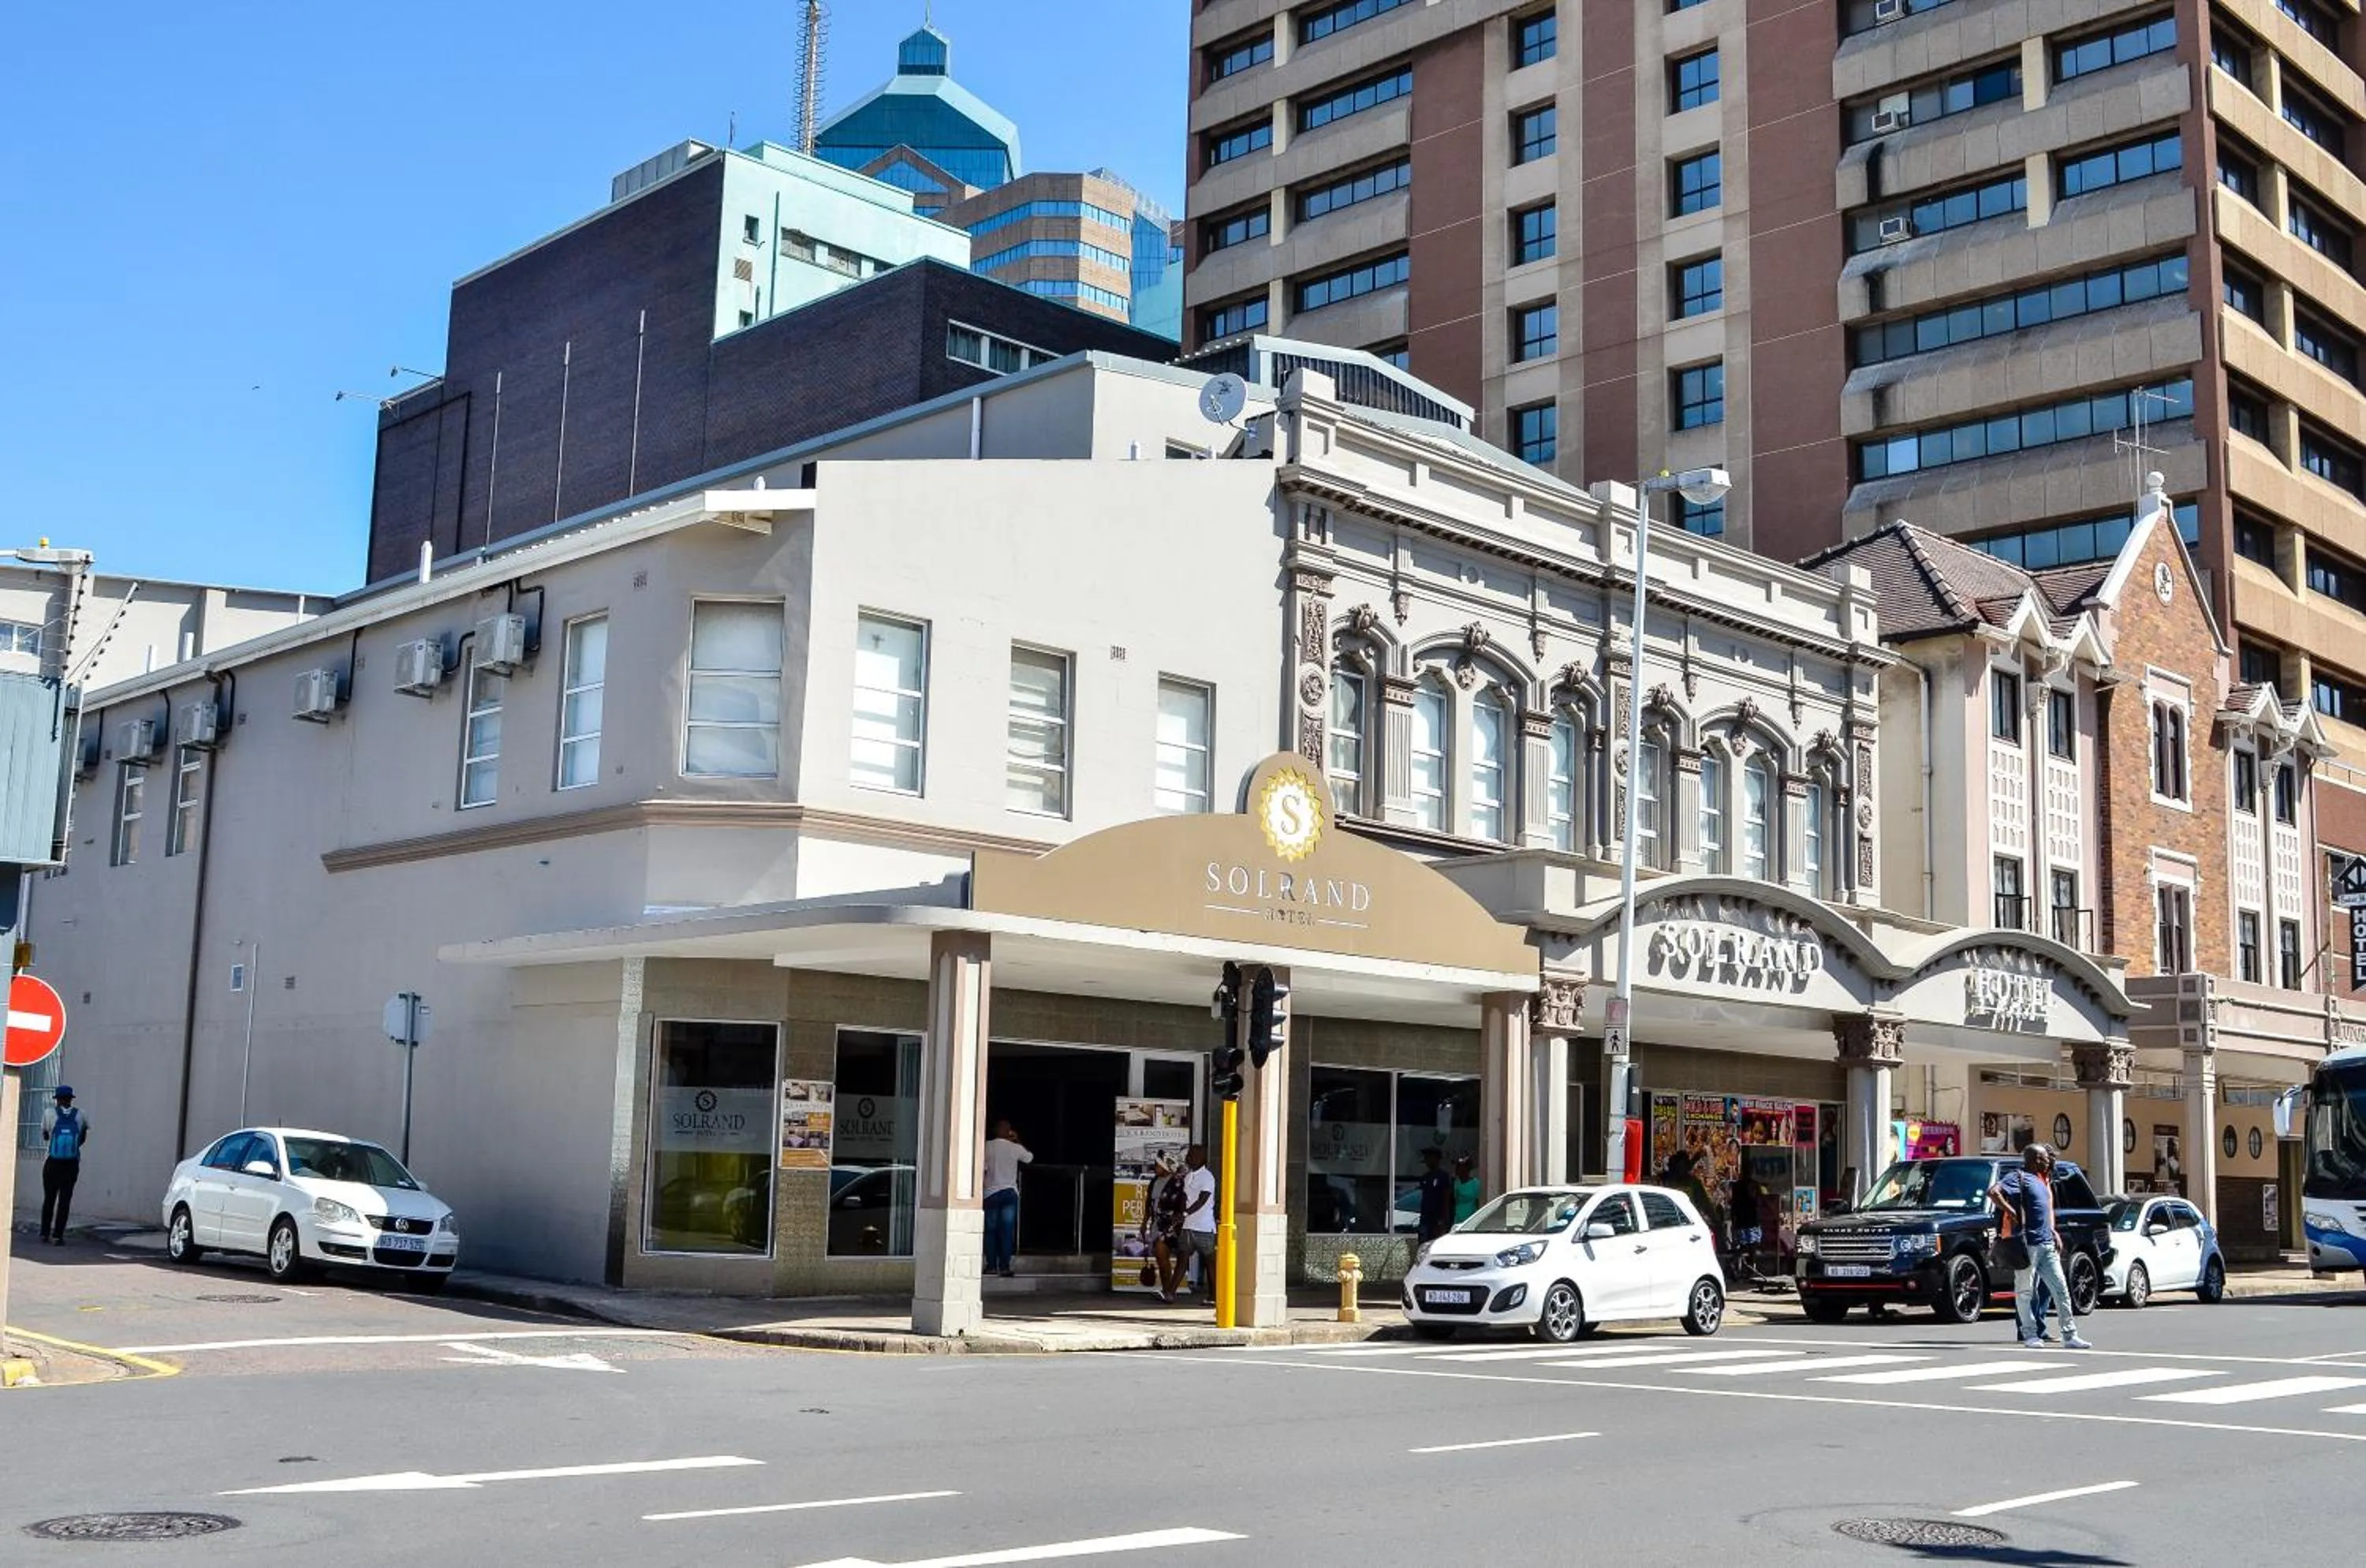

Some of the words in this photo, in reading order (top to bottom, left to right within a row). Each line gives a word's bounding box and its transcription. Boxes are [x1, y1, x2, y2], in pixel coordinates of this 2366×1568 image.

[1280, 794, 1301, 835] S
[1207, 861, 1371, 912] SOLRAND
[1263, 908, 1315, 927] HOTEL
[1662, 921, 1824, 976] SOLRAND
[2353, 909, 2366, 981] HOTEL
[1976, 966, 2055, 1010] HOTEL
[673, 1113, 745, 1131] SOLRAND
